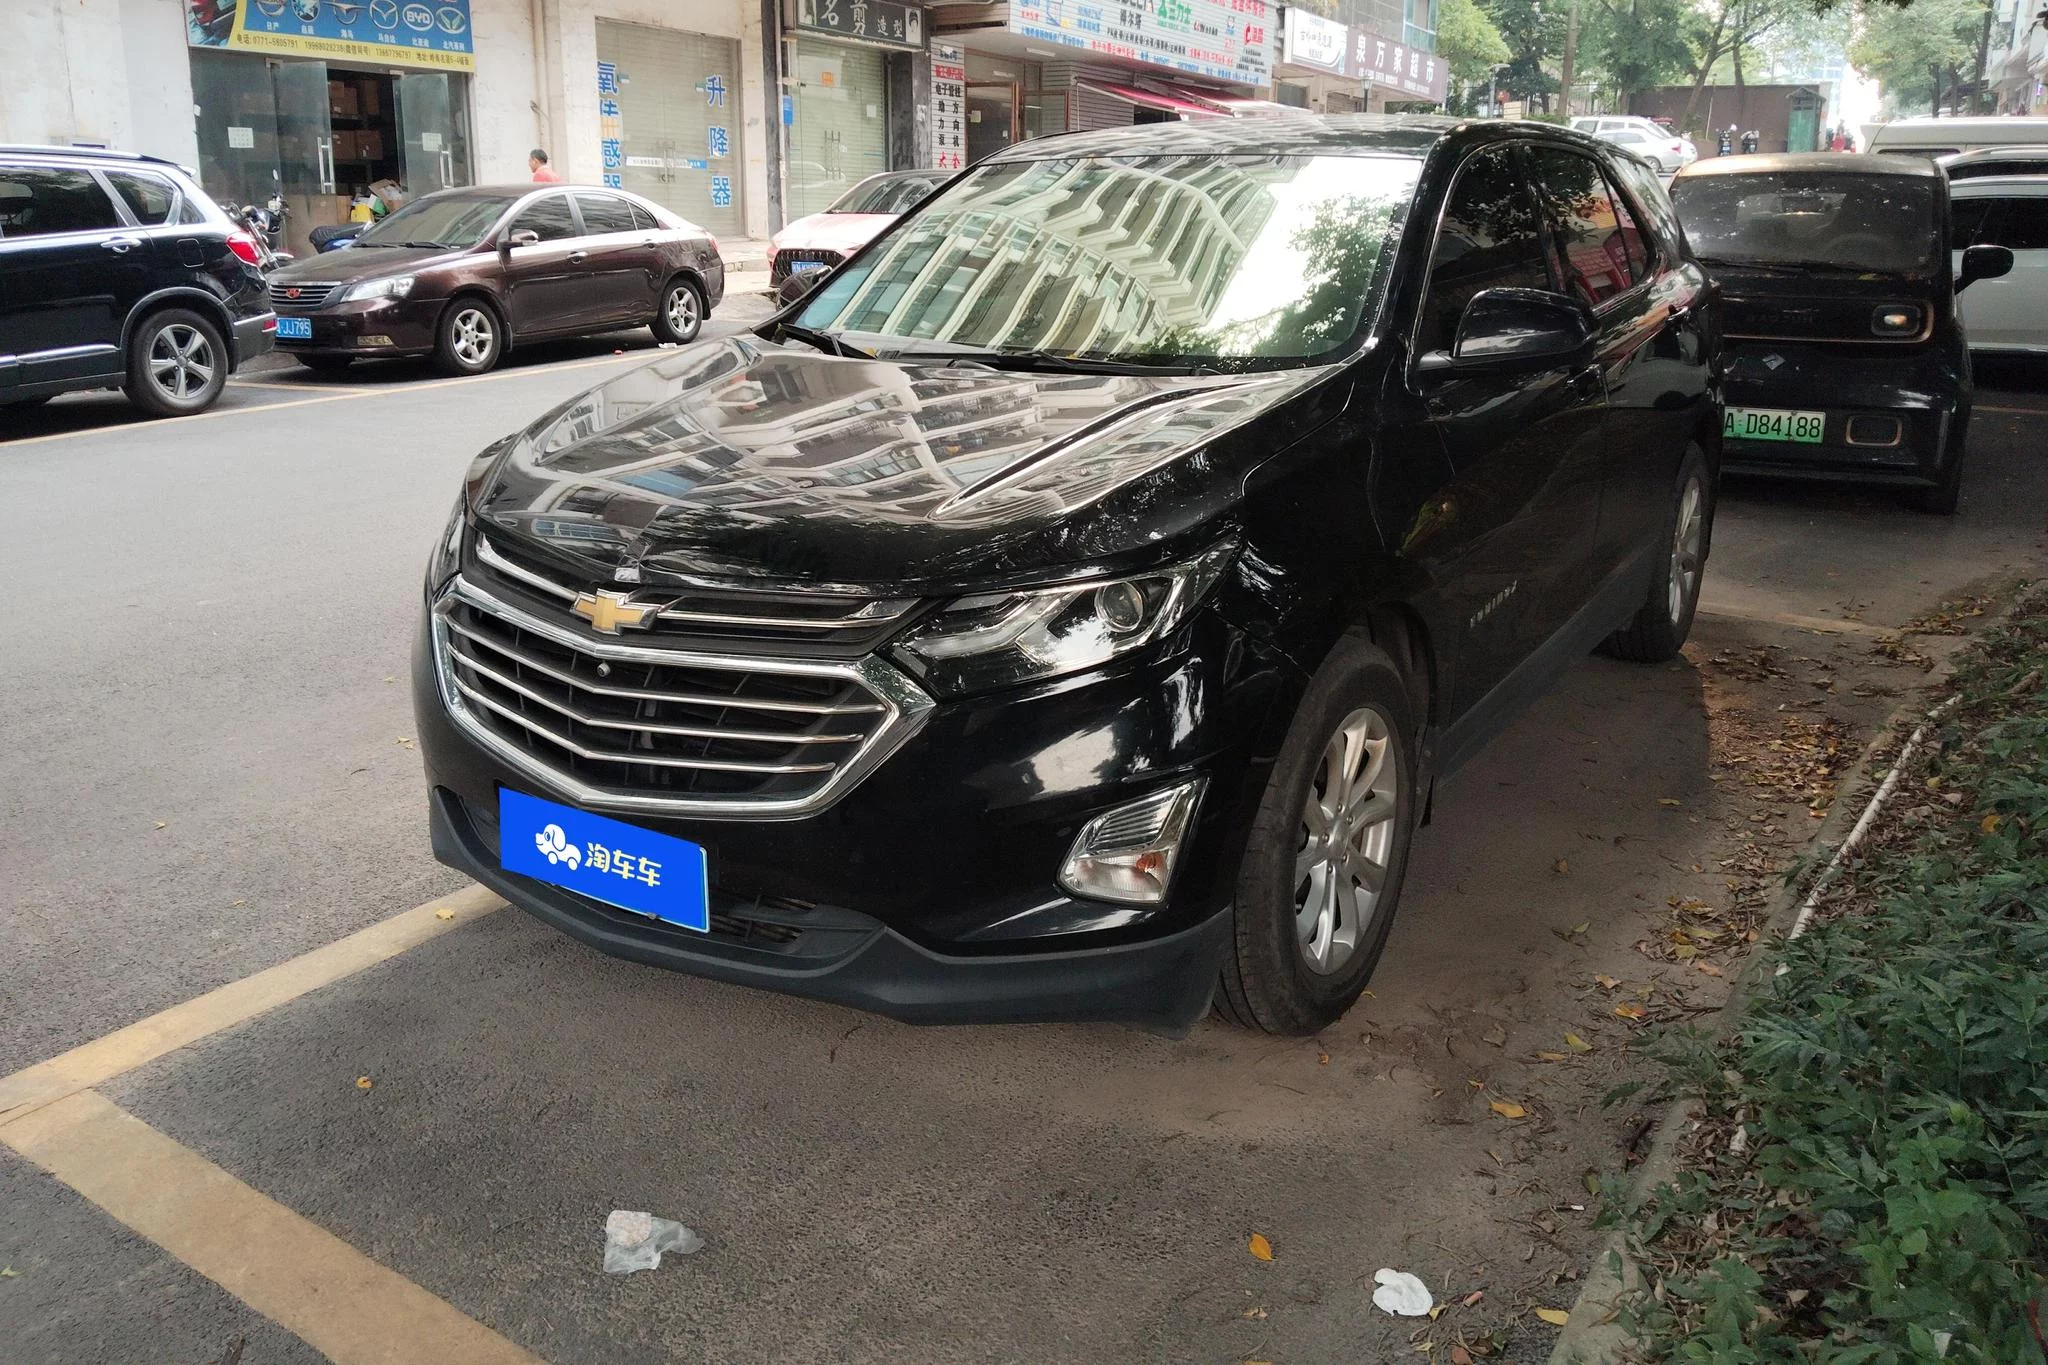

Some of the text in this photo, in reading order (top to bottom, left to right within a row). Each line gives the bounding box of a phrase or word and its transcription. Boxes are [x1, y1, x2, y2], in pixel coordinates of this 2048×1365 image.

[406, 11, 430, 25] BYD
[705, 75, 731, 207] 升降器
